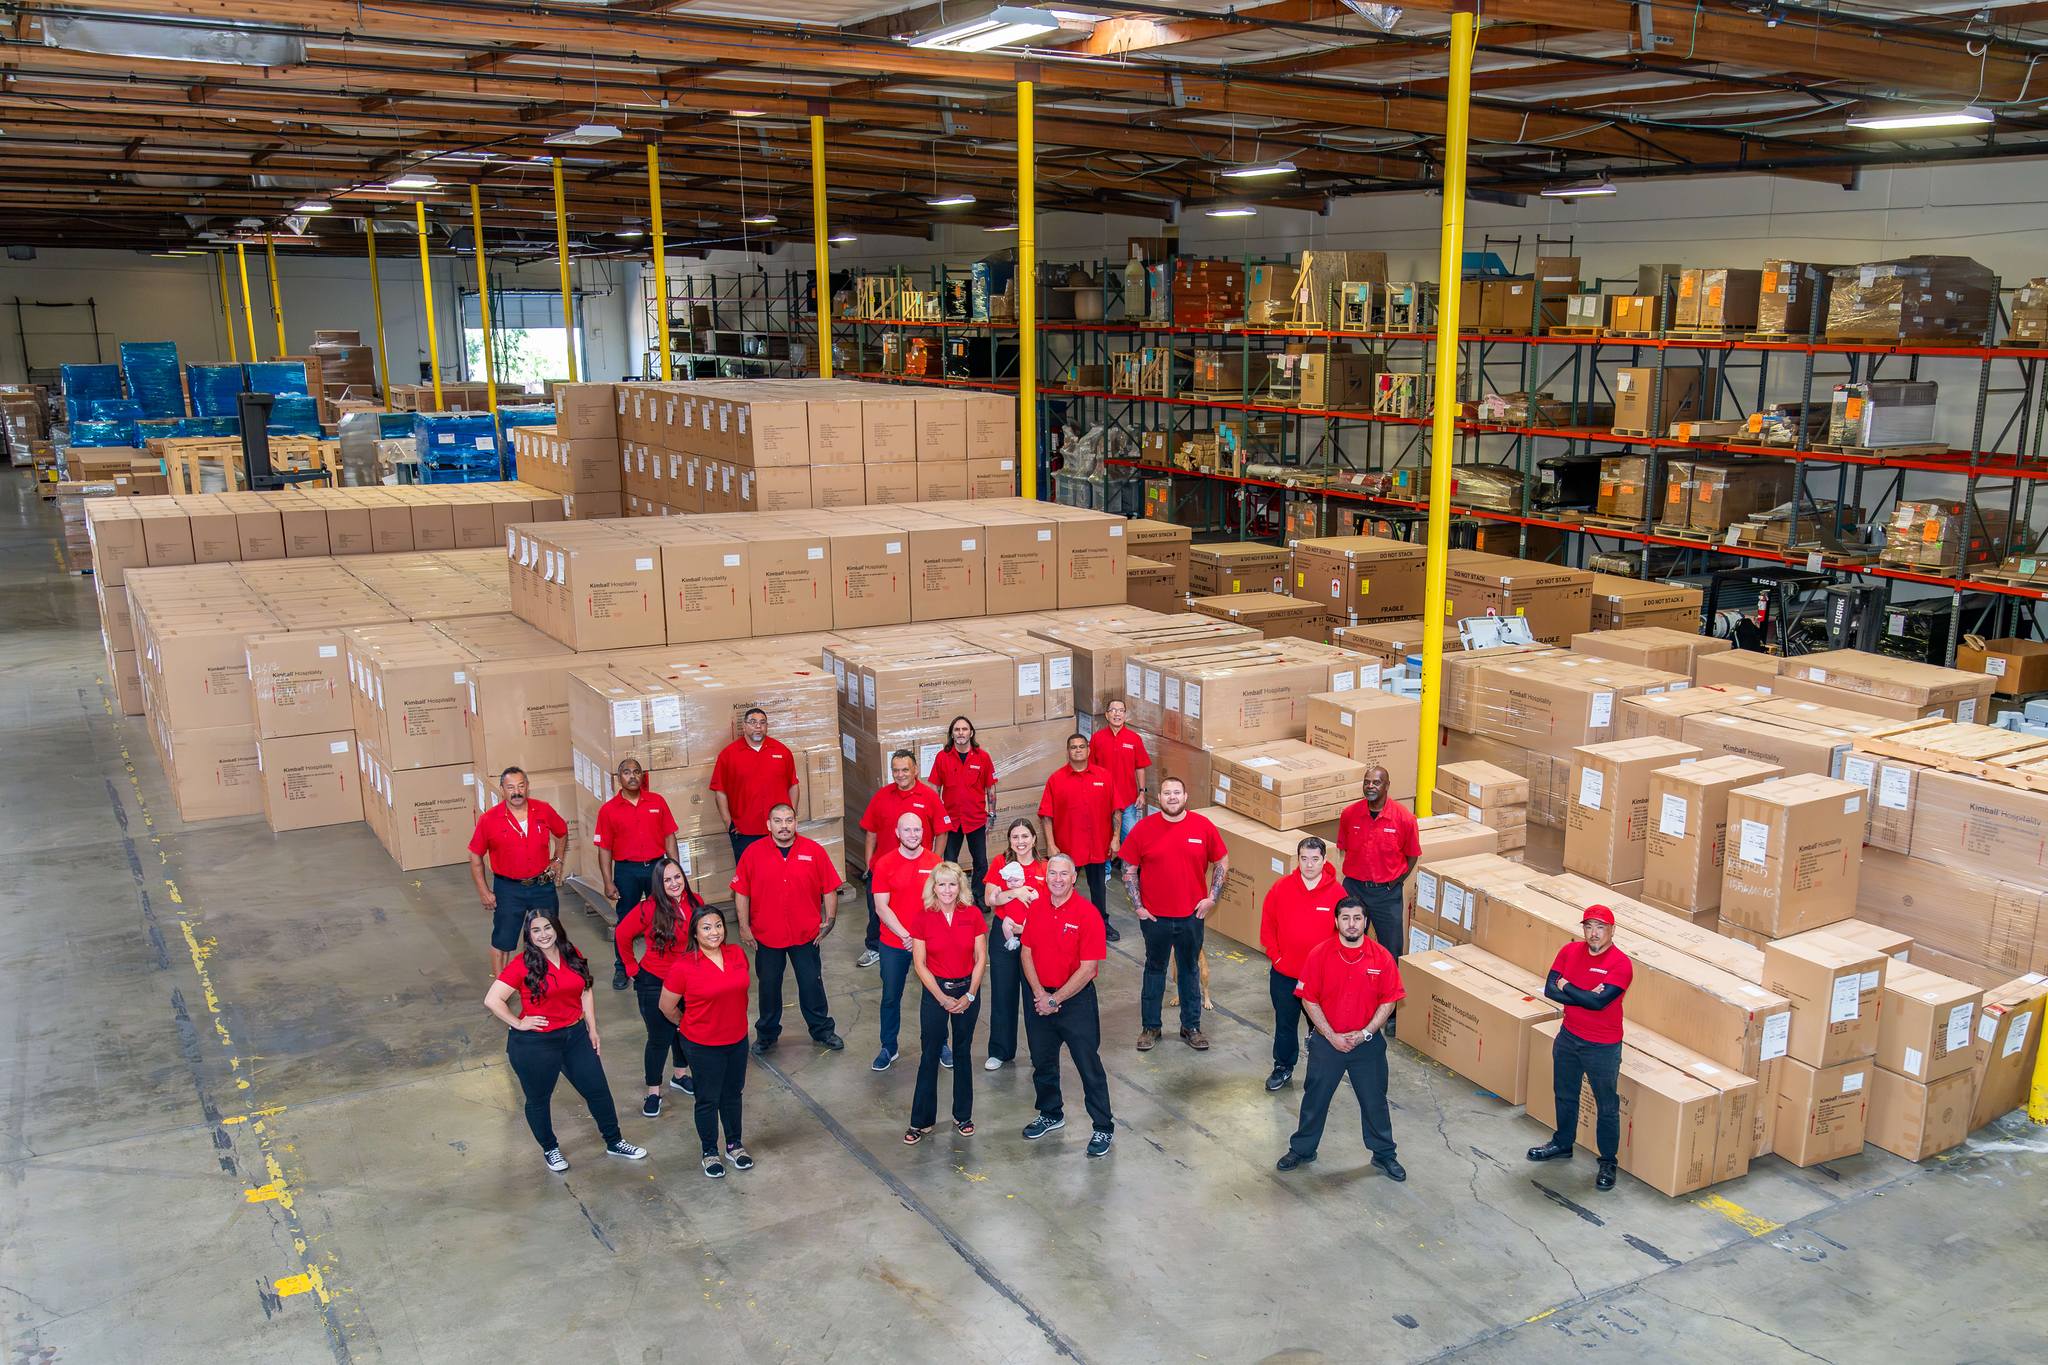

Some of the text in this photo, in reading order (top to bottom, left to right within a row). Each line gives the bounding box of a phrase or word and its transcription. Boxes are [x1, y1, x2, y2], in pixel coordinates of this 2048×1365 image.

[1555, 576, 1572, 584] STACK
[1381, 605, 1404, 613] FRAGILE
[1834, 598, 1845, 625] CLARK
[919, 678, 972, 687] Kimball Hospitality
[1243, 688, 1263, 696] Kimball
[428, 697, 456, 705] Hospitality
[733, 701, 757, 710] Kimball
[1723, 744, 1779, 763] Kimball Hospitality
[284, 763, 333, 773] Kimball Hospitality
[437, 797, 466, 806] Hospitality
[1970, 803, 2040, 826] Kimball Hospitality
[1799, 842, 1817, 852] Kimball
[1432, 993, 1451, 1009] Kimball
[1453, 1004, 1479, 1025] Hospitality
